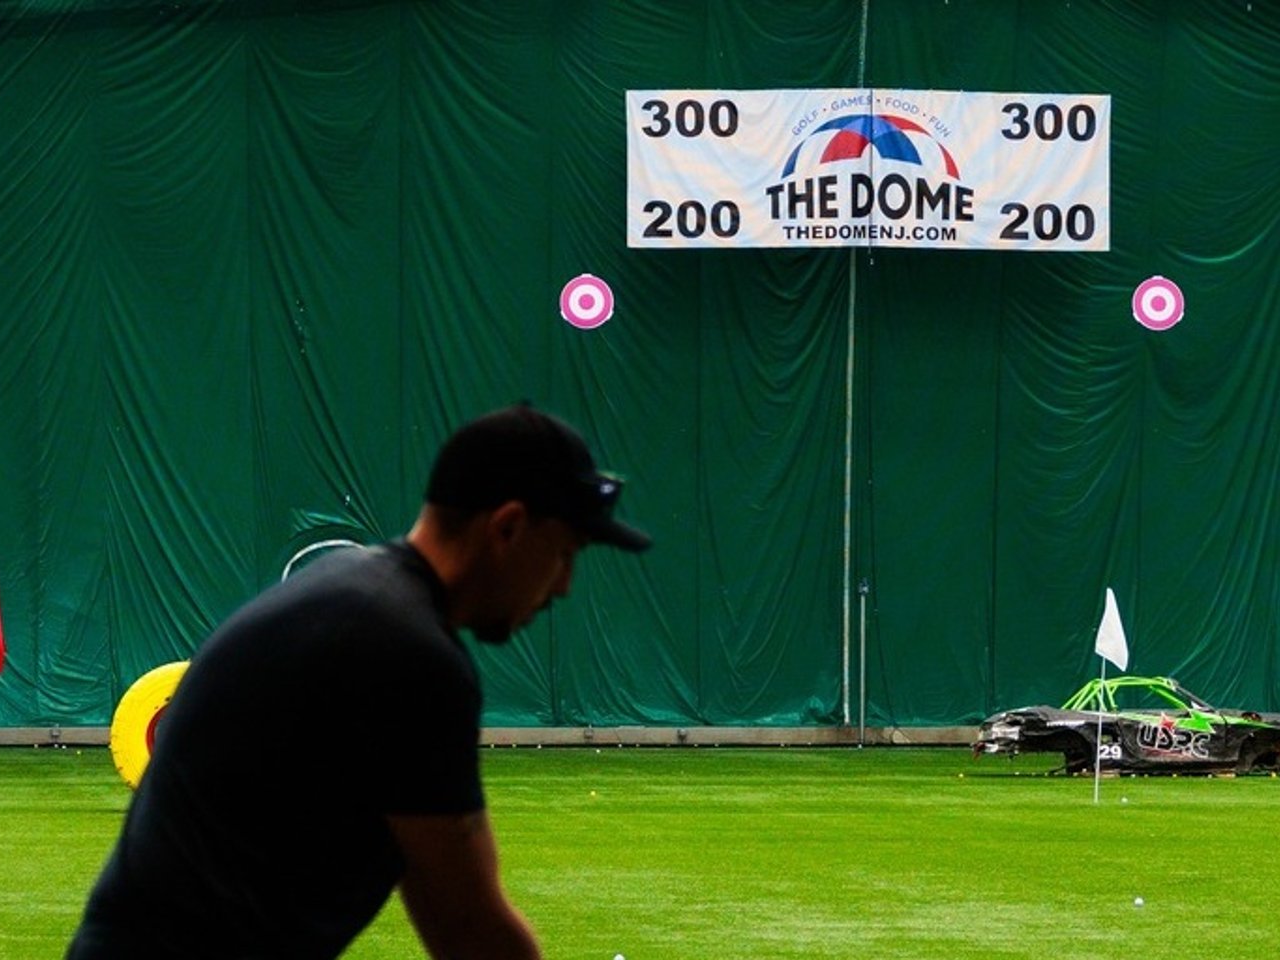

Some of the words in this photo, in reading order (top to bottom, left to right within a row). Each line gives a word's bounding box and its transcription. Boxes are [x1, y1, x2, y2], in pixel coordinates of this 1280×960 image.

[641, 100, 739, 138] 300
[792, 110, 820, 136] GOLF
[831, 95, 872, 112] GAMES
[885, 97, 919, 115] FOOD
[929, 116, 952, 138] FUN
[1000, 103, 1097, 141] 300
[765, 175, 839, 220] THE
[851, 173, 975, 222] DOME
[642, 200, 741, 239] 200
[783, 225, 957, 242] THEDOMENJ.COM
[999, 203, 1096, 241] 200
[1100, 744, 1122, 759] 29
